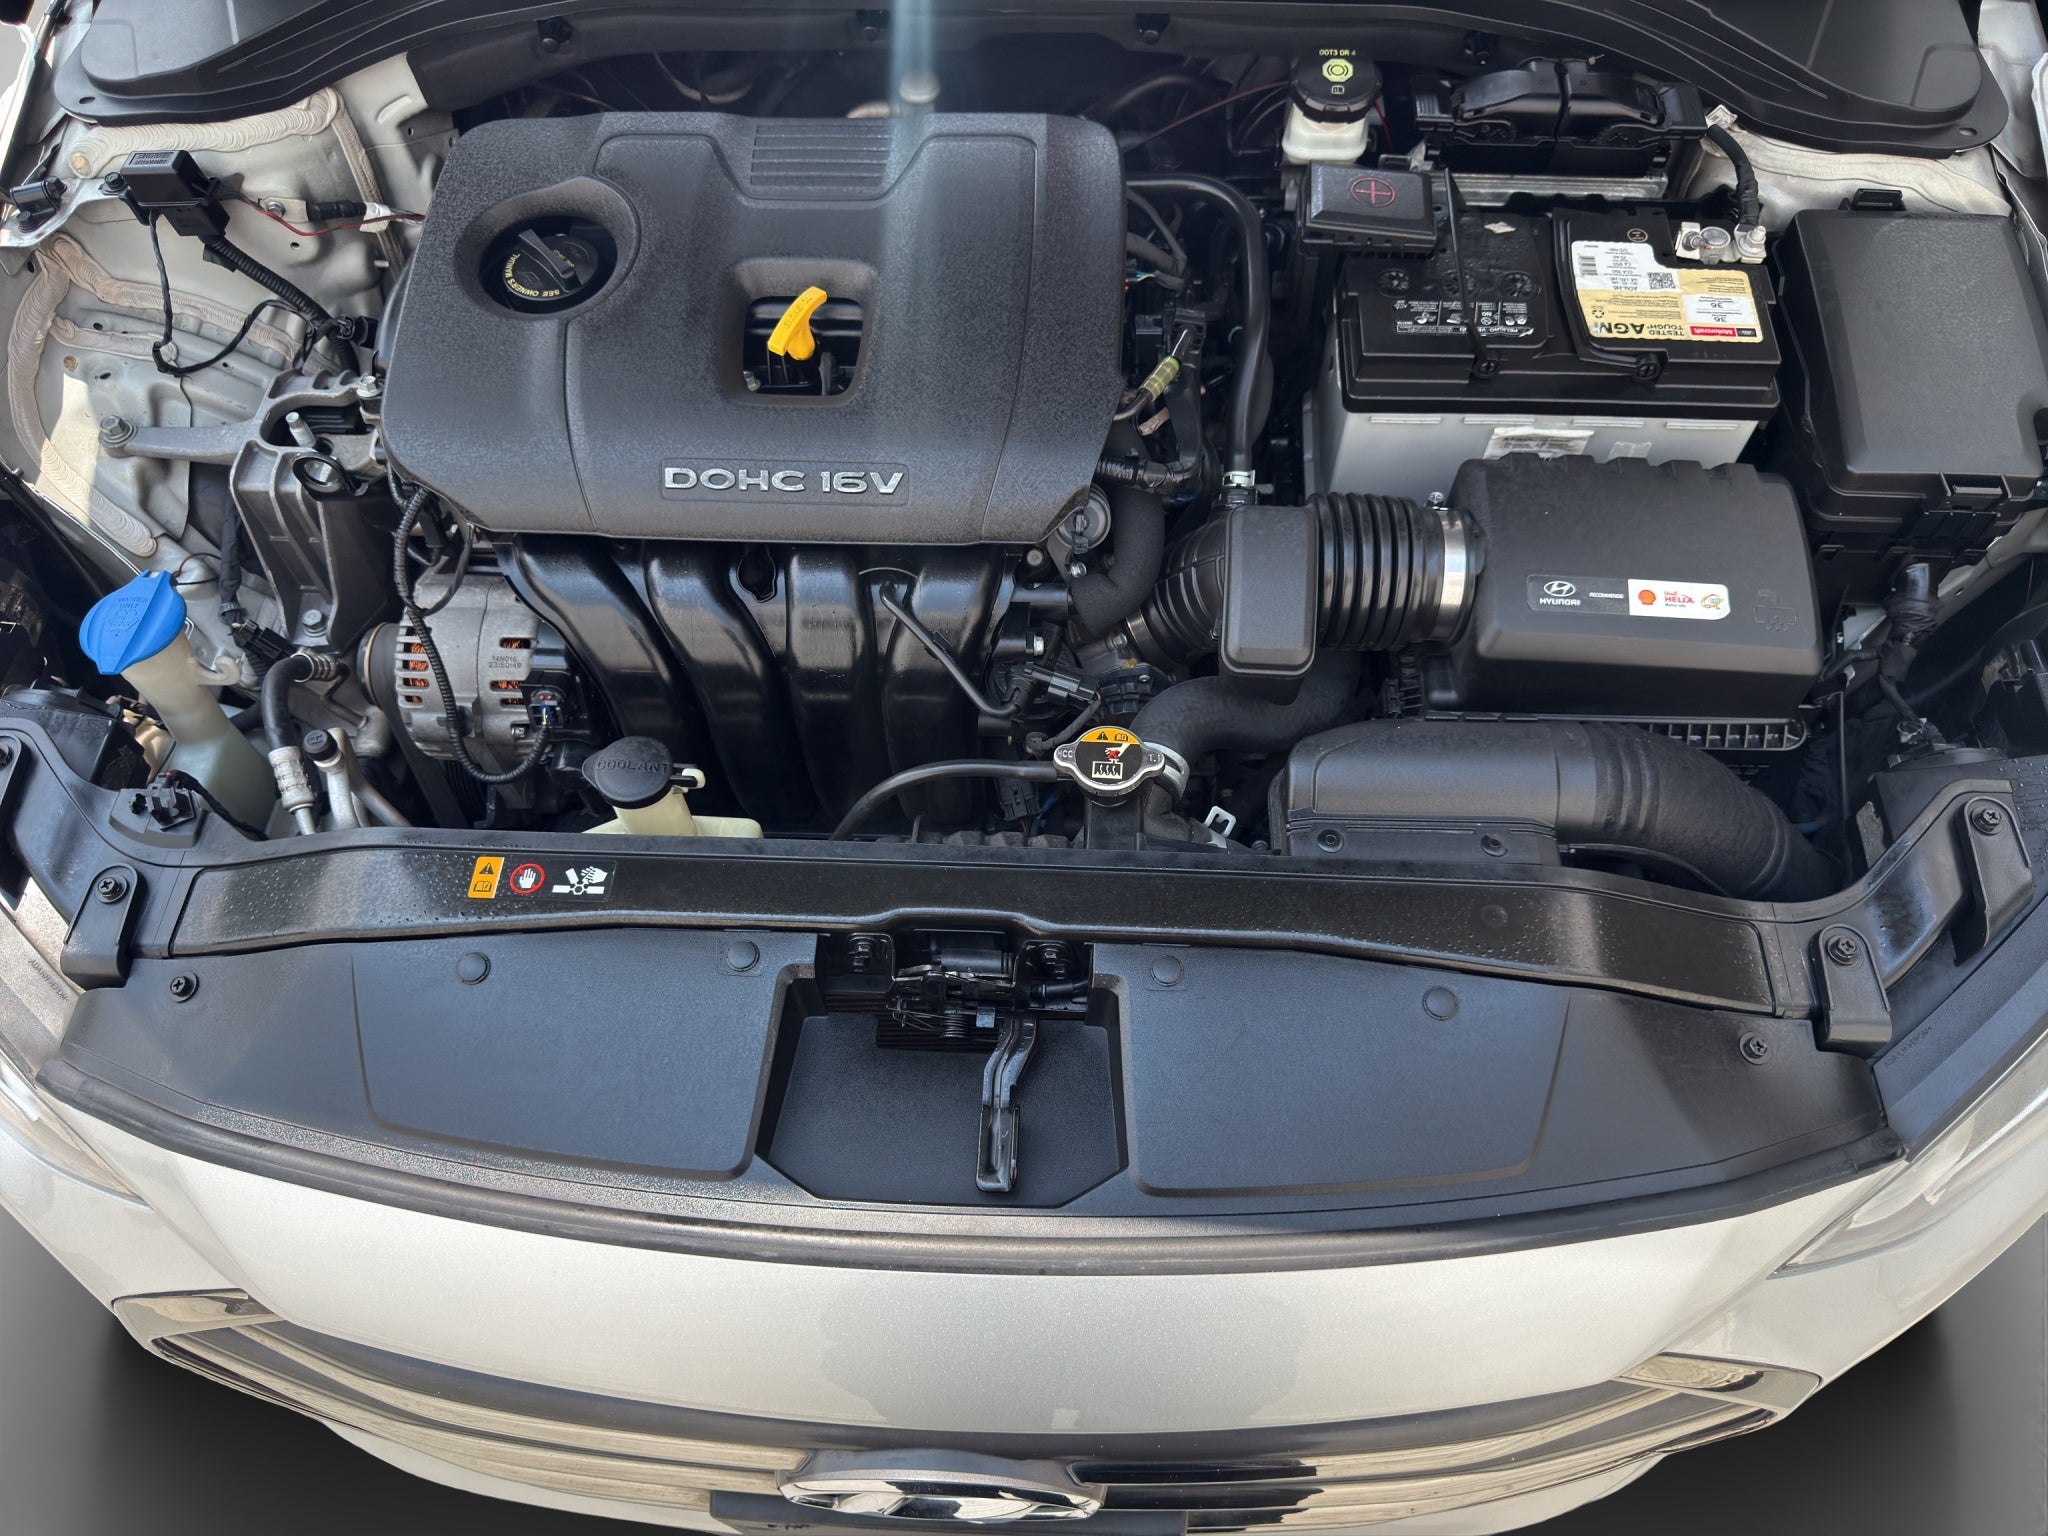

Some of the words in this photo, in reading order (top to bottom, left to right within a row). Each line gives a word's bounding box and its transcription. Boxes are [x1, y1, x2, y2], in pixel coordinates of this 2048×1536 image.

[505, 253, 521, 279] MANUAL
[508, 278, 540, 297] OWNER'S
[664, 467, 807, 492] DOHC
[820, 471, 904, 494] 16V
[1539, 598, 1581, 606] HYUNDAI
[1664, 595, 1695, 604] HELIX
[596, 760, 670, 774] COOLANT
